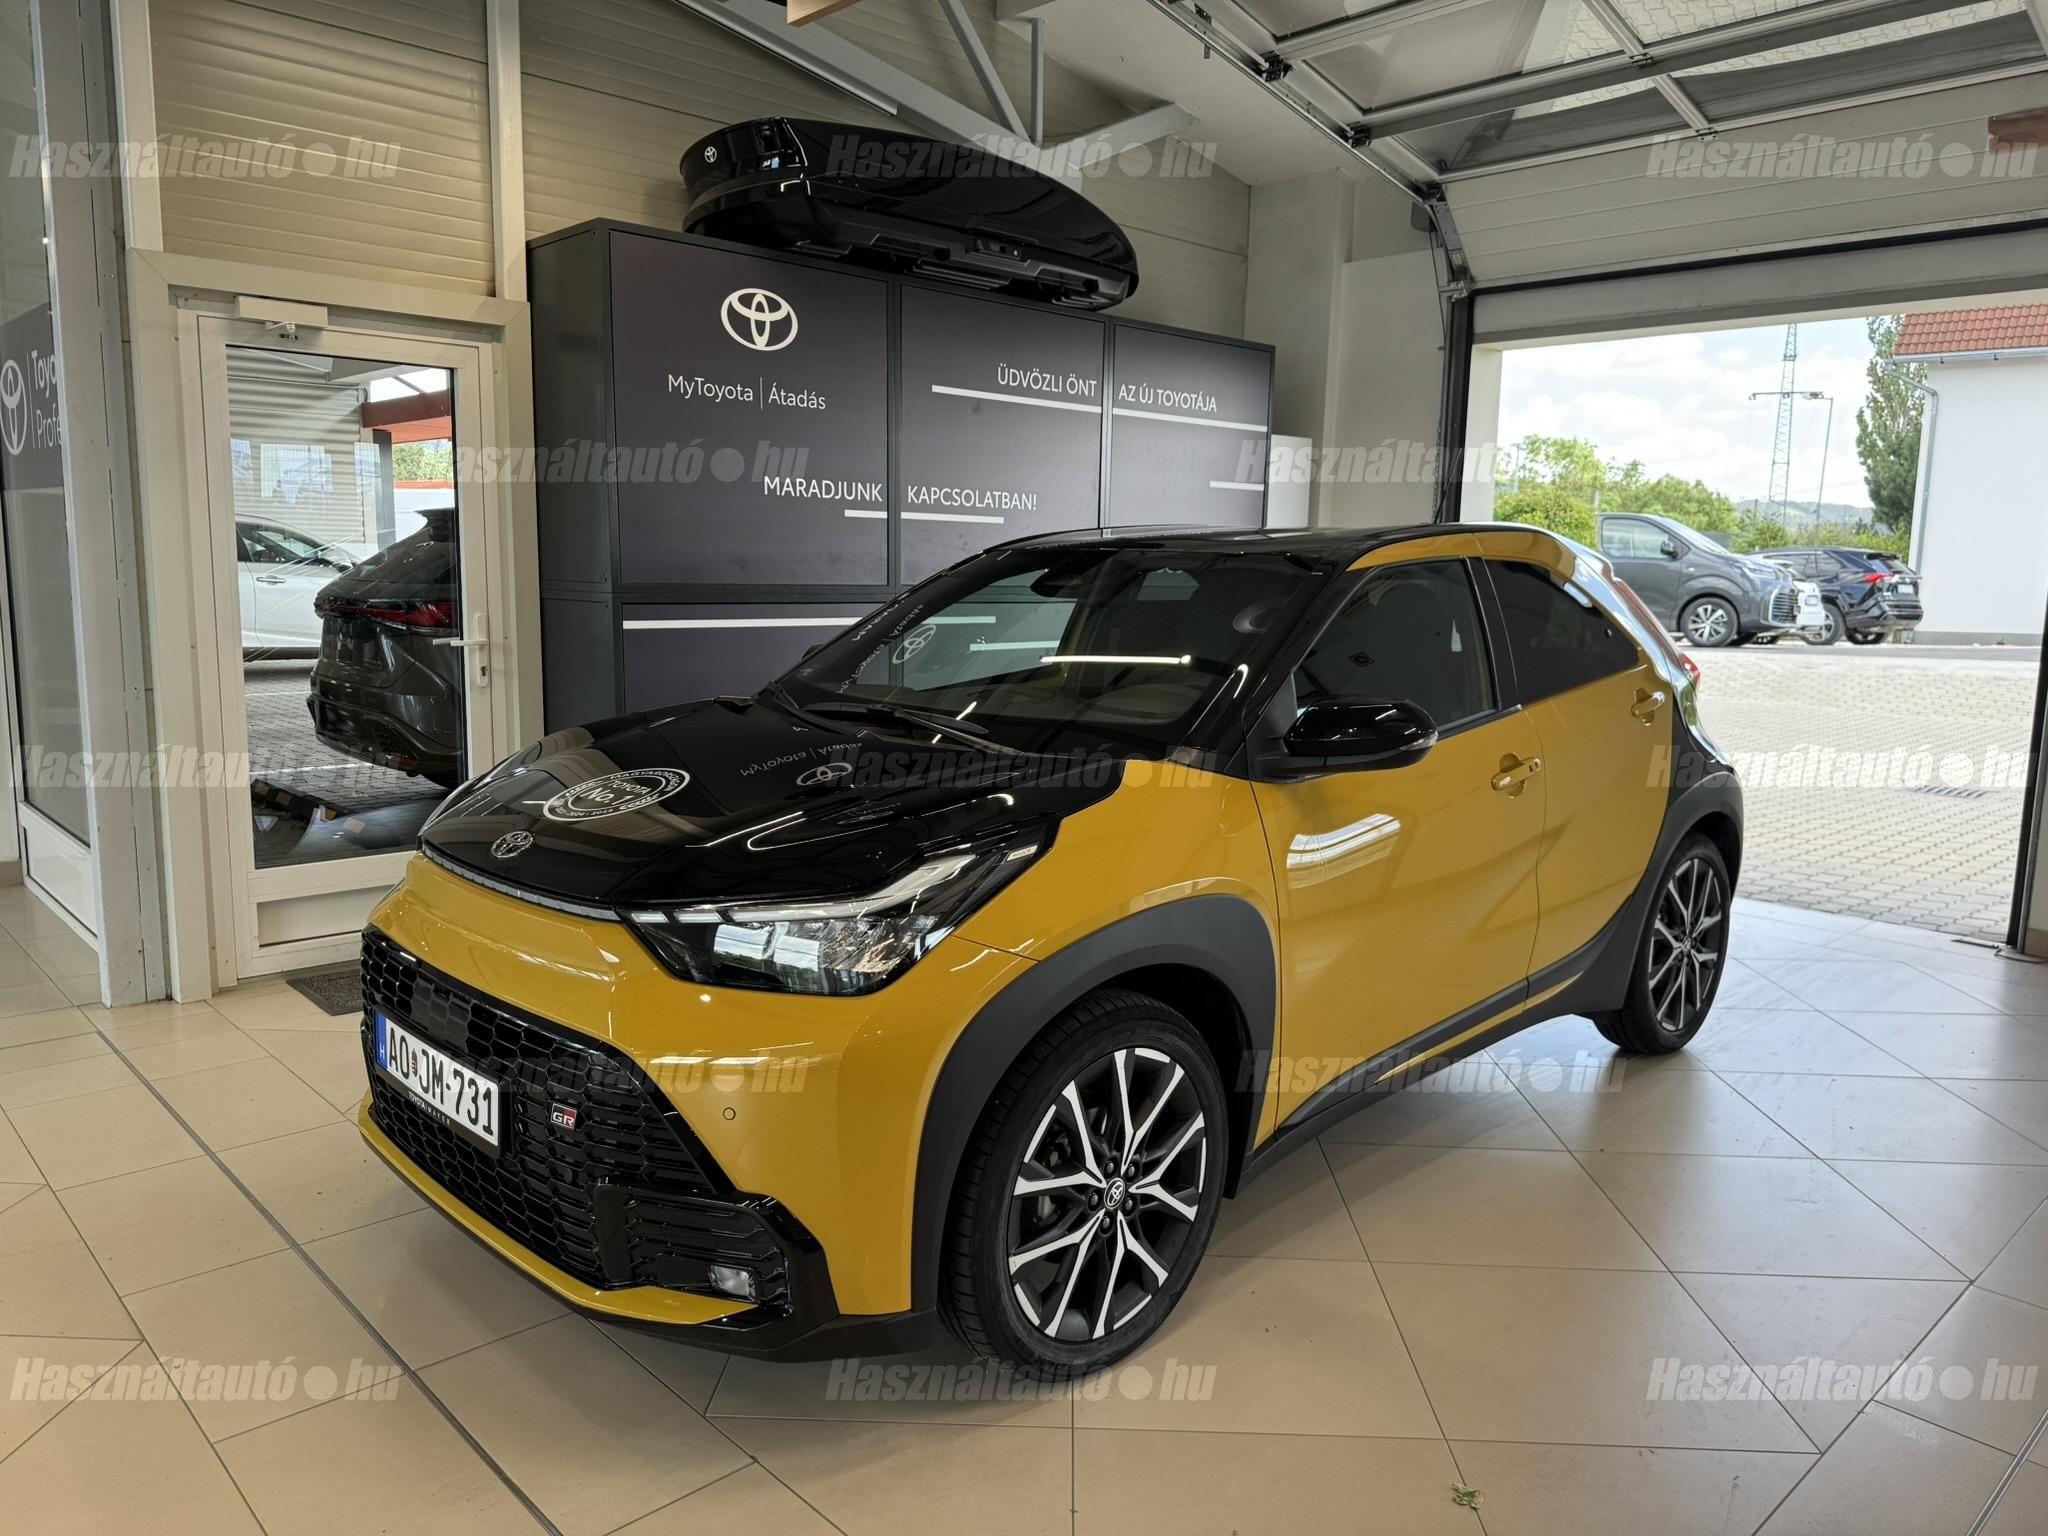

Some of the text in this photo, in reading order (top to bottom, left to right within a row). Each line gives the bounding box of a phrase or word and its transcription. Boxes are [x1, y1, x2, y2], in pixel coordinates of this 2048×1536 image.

[667, 374, 827, 411] MyToyota Átadás
[997, 363, 1218, 413] ÜDVÖZLI ÖNT AZ ÚJ TOYOTÁJA
[763, 476, 1038, 512] MARADJUNK KAPCSOLATBAN!
[608, 780, 652, 795] TOYOTA
[552, 1110, 575, 1128] GR
